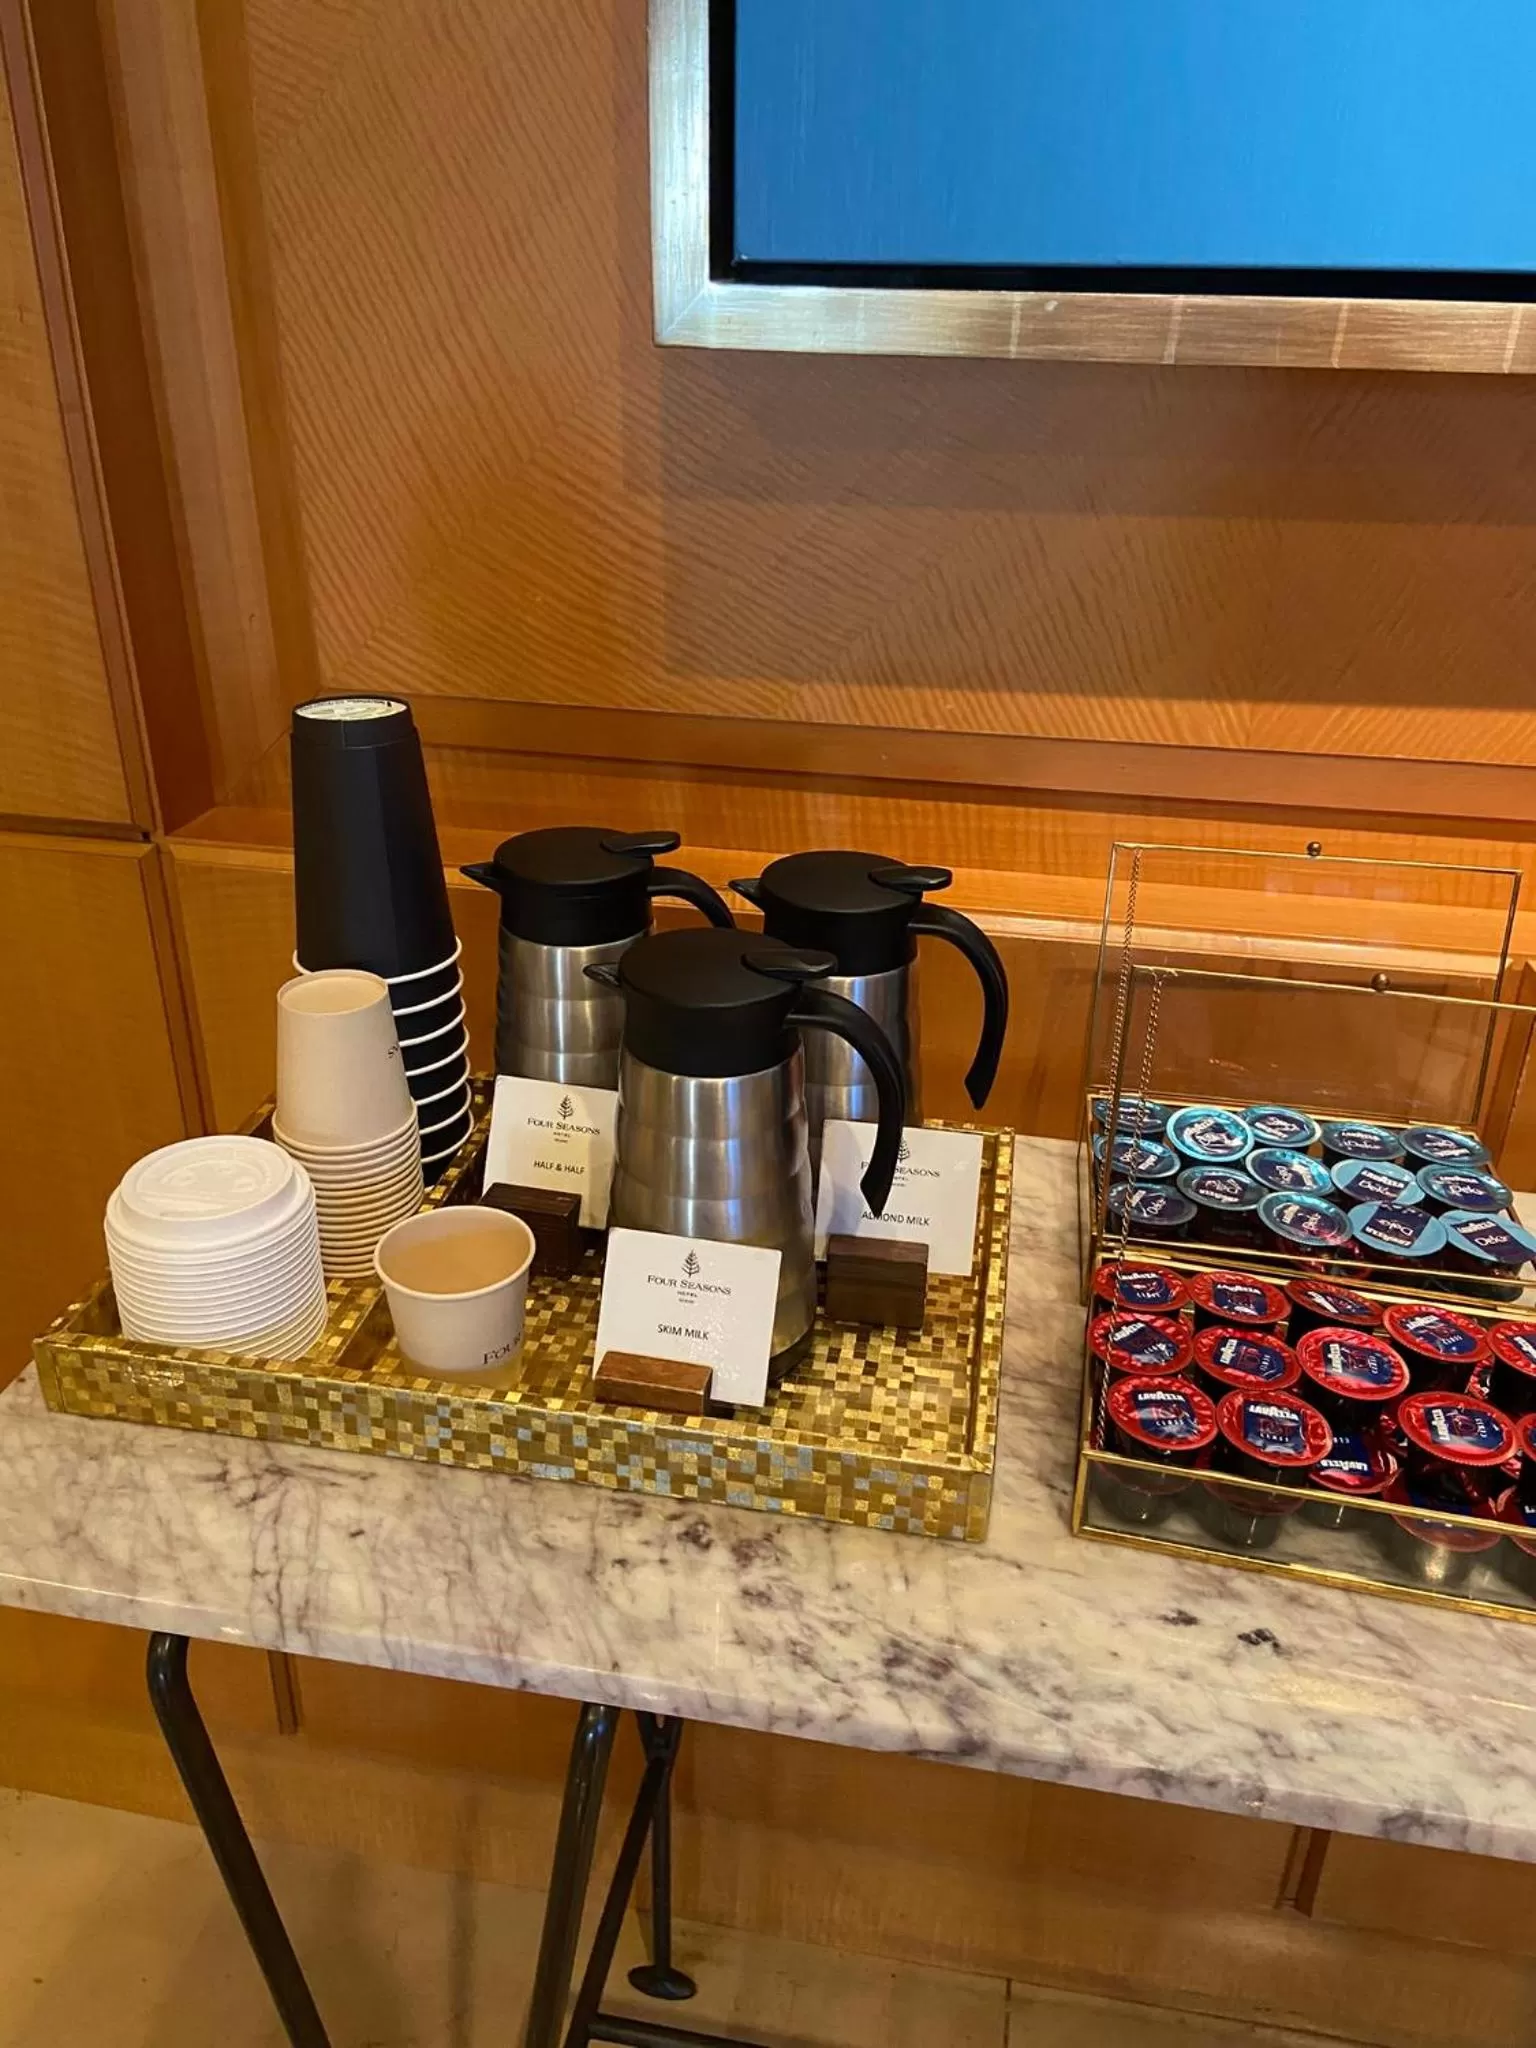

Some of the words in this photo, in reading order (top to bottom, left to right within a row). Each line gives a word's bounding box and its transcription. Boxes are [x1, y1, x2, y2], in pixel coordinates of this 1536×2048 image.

[527, 1117, 553, 1129] FOUR
[556, 1121, 600, 1136] SEASONS
[533, 1160, 554, 1170] HALF
[555, 1163, 563, 1172] &
[564, 1164, 585, 1175] HALF
[906, 1215, 930, 1226] MILK
[647, 1274, 677, 1287] FOUR
[680, 1279, 732, 1295] SEASONS
[657, 1323, 682, 1336] SKIM
[684, 1328, 709, 1340] MILK
[1137, 1391, 1186, 1403] LAVAZZA
[1248, 1404, 1300, 1421] LAVAZZA
